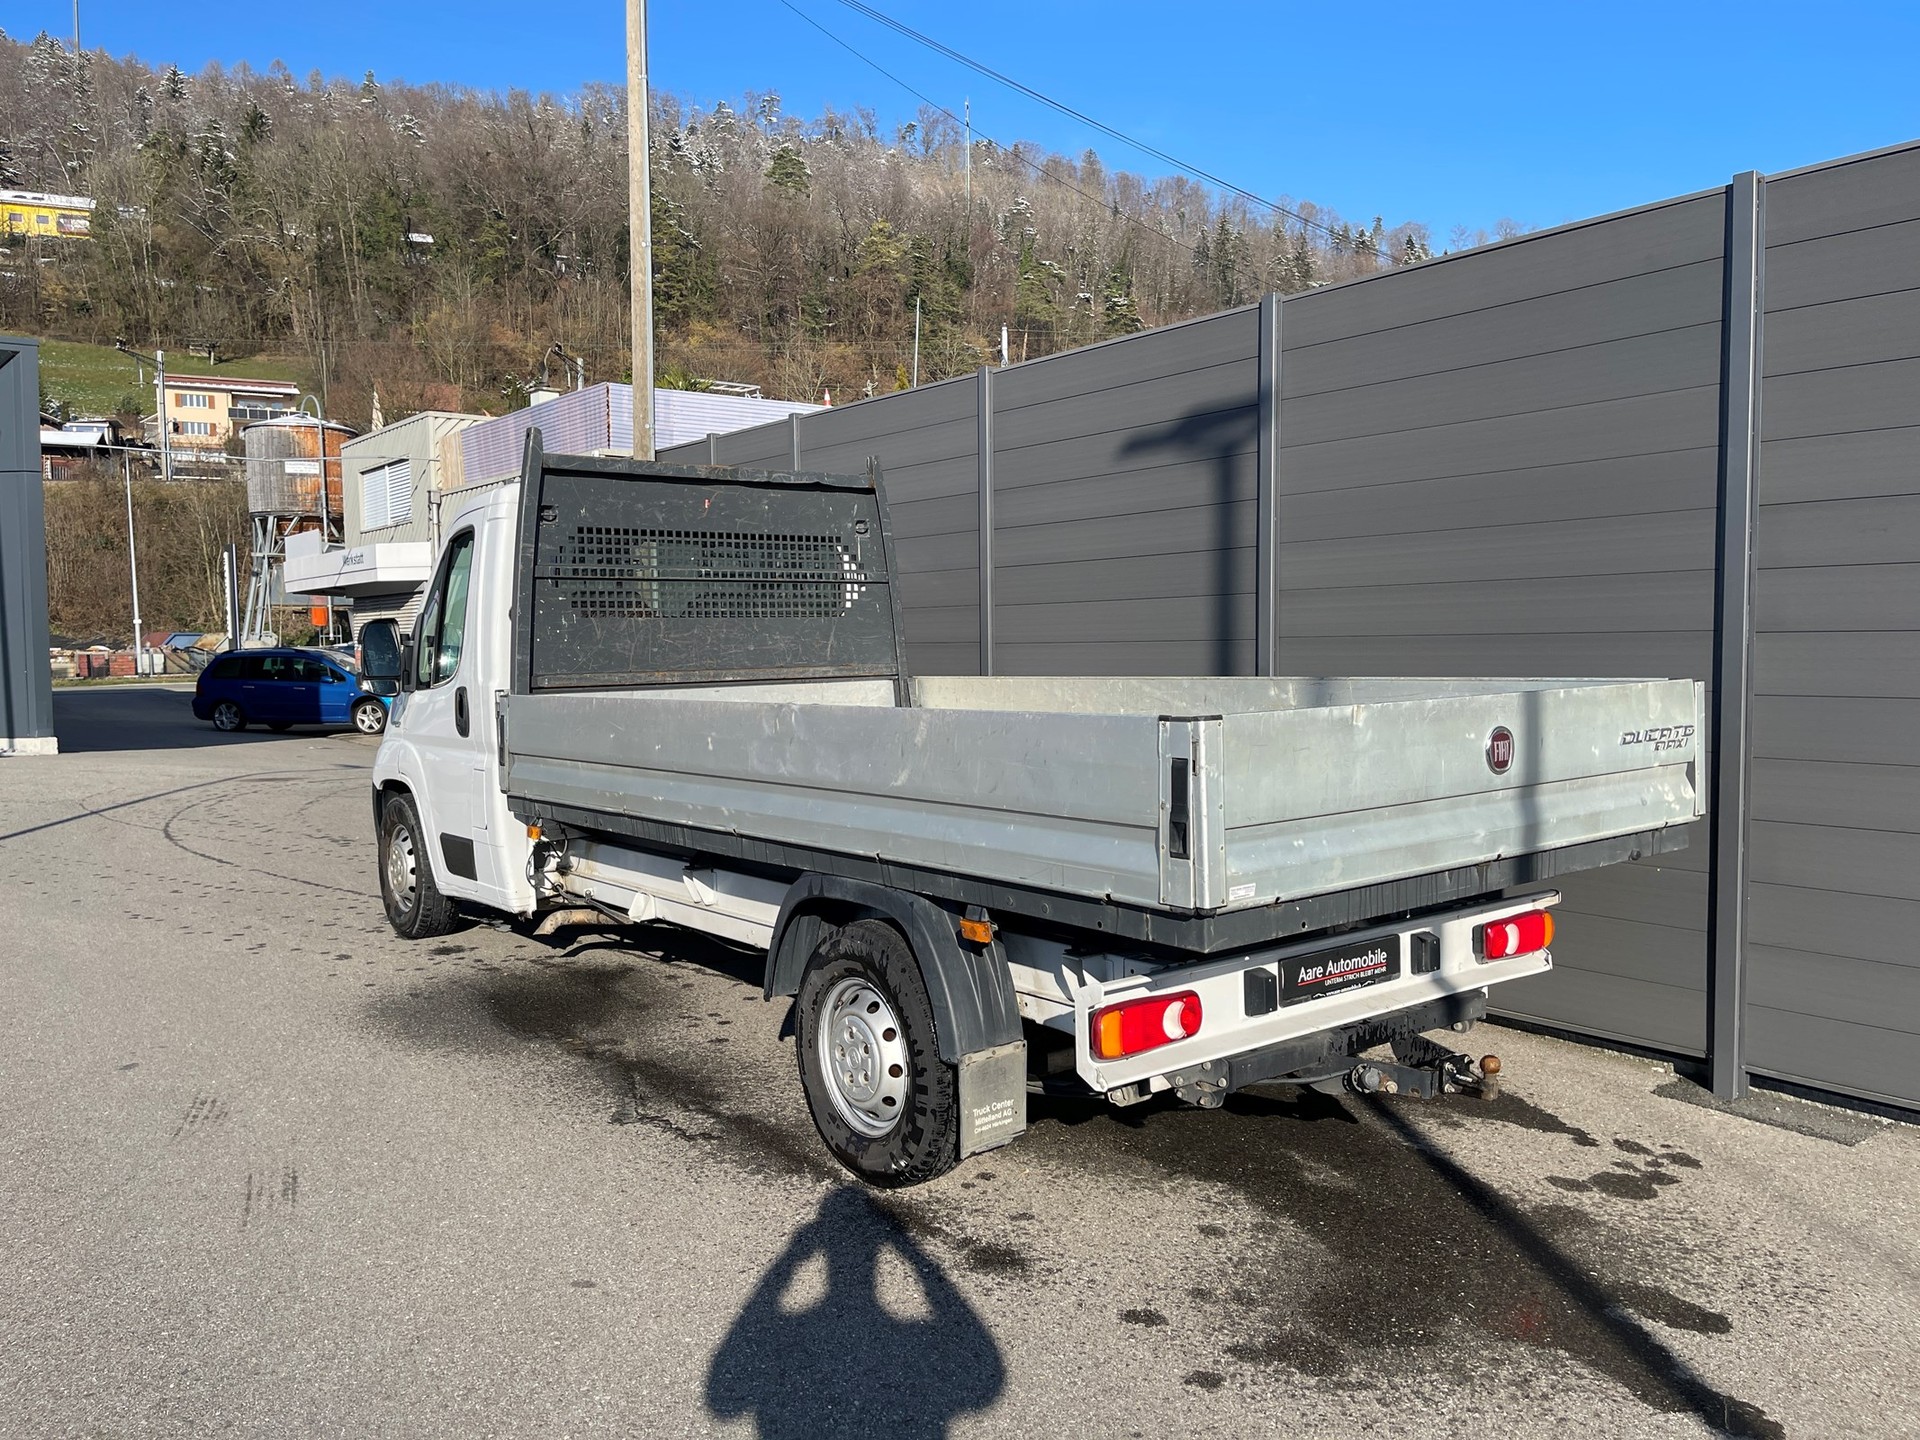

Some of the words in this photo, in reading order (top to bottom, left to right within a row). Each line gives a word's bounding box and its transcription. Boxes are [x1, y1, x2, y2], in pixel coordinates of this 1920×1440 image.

[1620, 725, 1695, 745] DUCATO
[1653, 737, 1689, 751] MAXI
[1493, 739, 1510, 762] FIAT
[1298, 965, 1323, 983] Aare
[1325, 948, 1388, 976] Automobile
[1324, 976, 1343, 986] UNTERM
[1343, 972, 1360, 982] STRICH
[1360, 969, 1374, 978] BLEIBT
[1374, 966, 1387, 974] MEHR
[972, 1104, 991, 1117] Truck
[991, 1099, 1015, 1111] Center
[1002, 1108, 1012, 1118] AG
